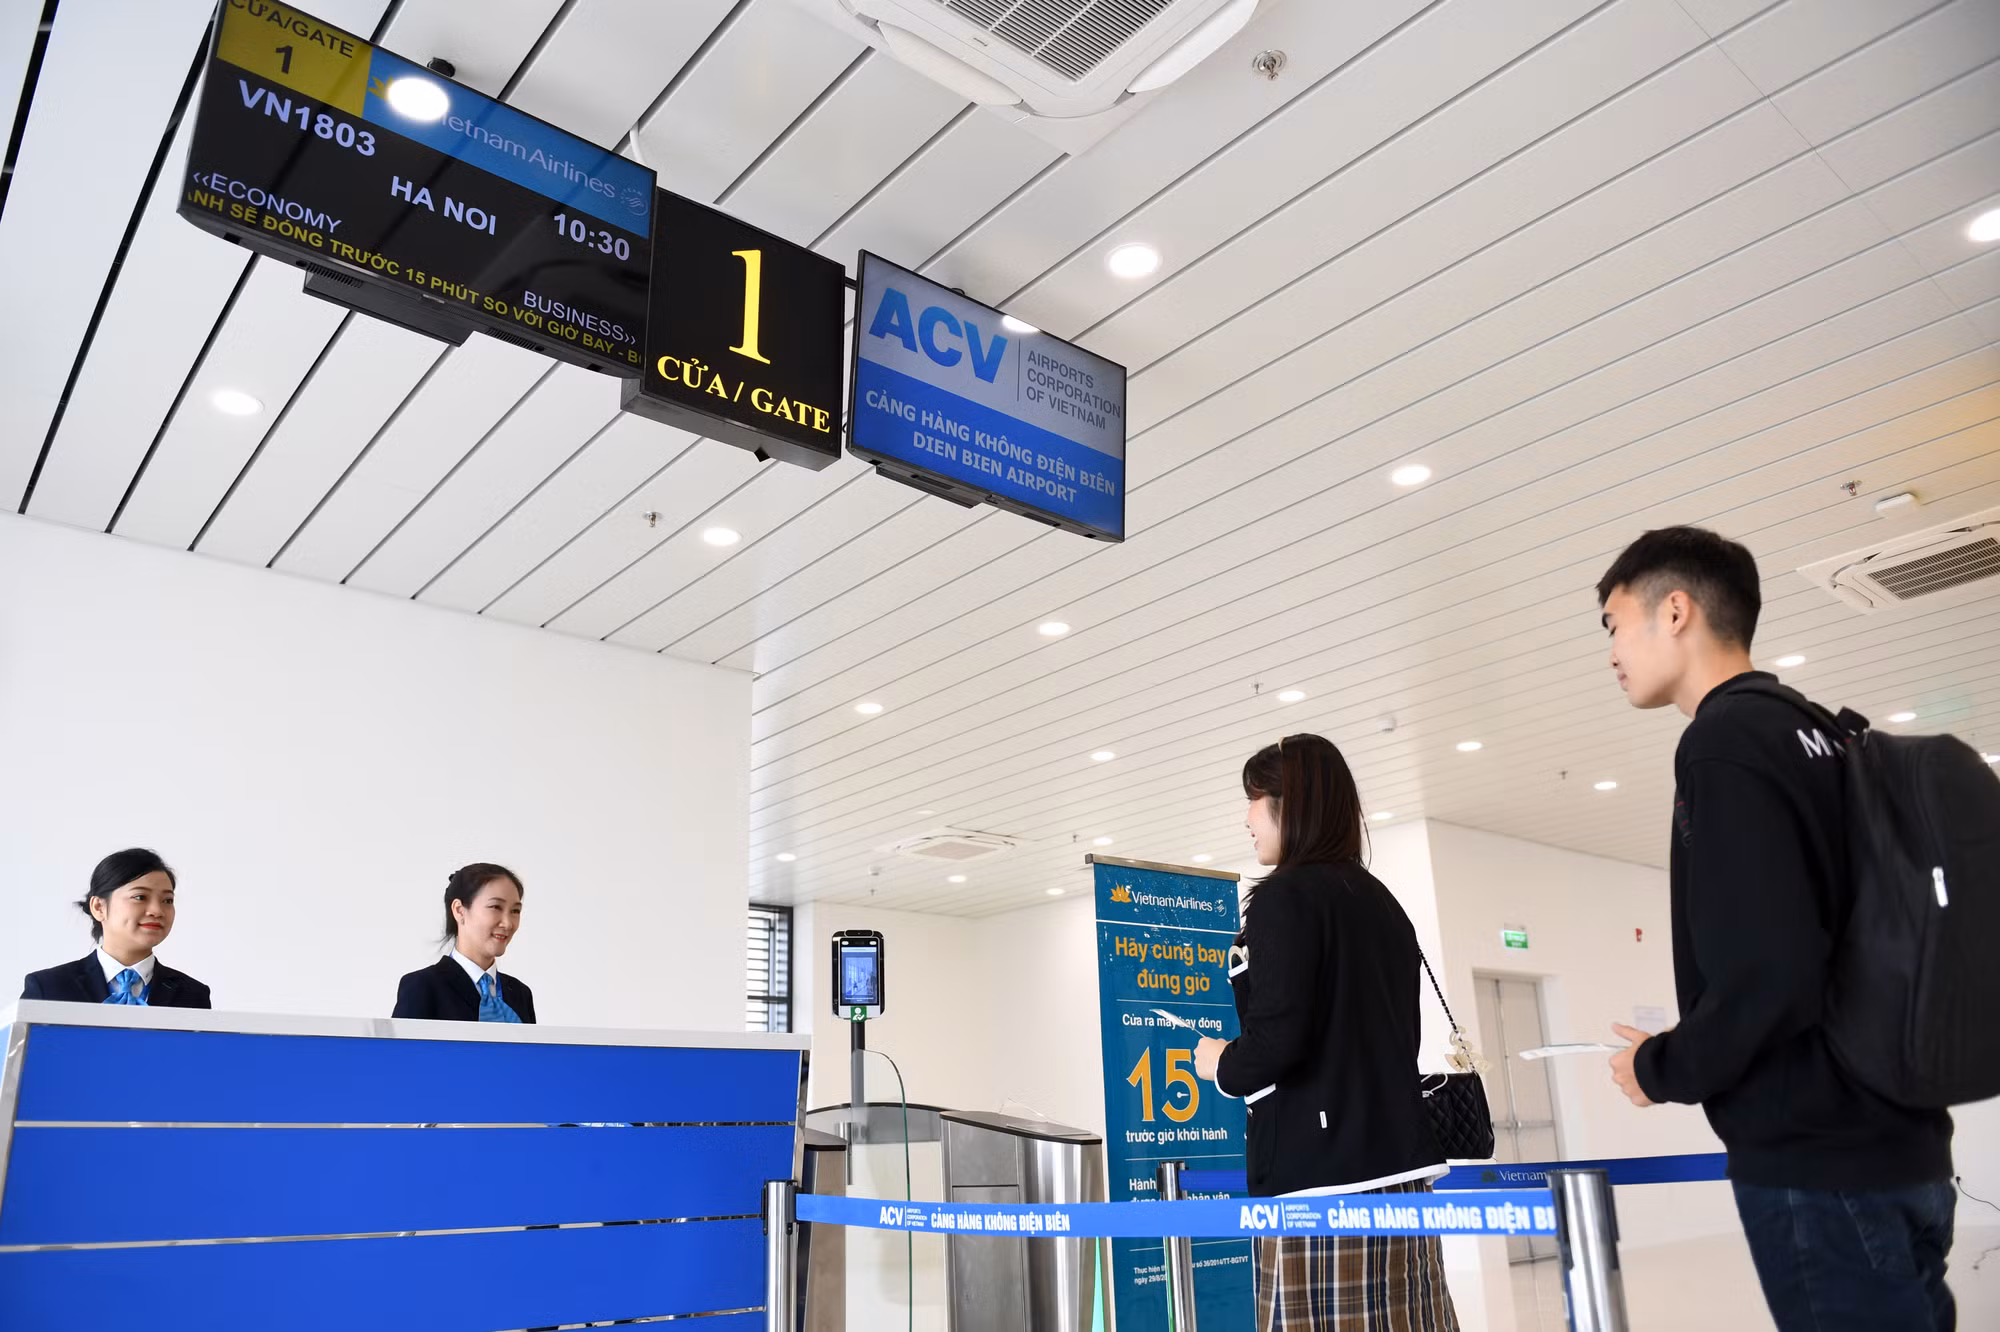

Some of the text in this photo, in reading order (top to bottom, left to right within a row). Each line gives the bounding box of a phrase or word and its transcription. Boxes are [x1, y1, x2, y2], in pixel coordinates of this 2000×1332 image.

[275, 45, 294, 75] 1
[238, 79, 376, 157] VN1803
[391, 175, 497, 236] HA NOI
[553, 213, 631, 261] 10:30
[230, 203, 258, 224] SẼ
[263, 215, 324, 248] ĐÓNG
[330, 239, 400, 275] TRƯỚC
[405, 268, 426, 285] 15
[430, 276, 480, 304] PHÚT
[483, 297, 508, 315] SO
[513, 306, 543, 328] VỚI
[547, 320, 579, 341] GIỜ
[583, 333, 615, 354] BAY
[628, 349, 641, 364] B
[729, 249, 771, 365] 1
[869, 287, 1009, 384] ACV
[1028, 350, 1094, 389] AIRPORTS
[656, 355, 729, 399] CỬA
[751, 388, 831, 433] GATE
[1026, 386, 1106, 430] OF VIETNAM
[1027, 368, 1121, 418] CORPORATION
[866, 389, 1116, 497] CẢNG HÀNG KHÔNG ĐIỆN BIÊN
[913, 431, 1077, 503] DIEN BIEN AIRPORT
[1115, 936, 1148, 963] Hãy
[1197, 943, 1226, 968] bay
[1137, 968, 1211, 996] đúng giờ
[1144, 1017, 1154, 1026] ra
[1198, 1016, 1222, 1031] đóng
[1126, 1046, 1200, 1123] 15
[1126, 1127, 1228, 1145] trước giờ khởi hành
[1129, 1177, 1157, 1191] Hành
[1499, 1169, 1547, 1182] Vietnam
[880, 1206, 904, 1226] ACV
[931, 1207, 1070, 1235] CẢNG HÀNG KHÔNG ĐIỆN BIÊN
[1240, 1203, 1279, 1230] ACV
[1327, 1200, 1557, 1234] CẢNG HÀNG KHÔNG ĐIỆN BI
